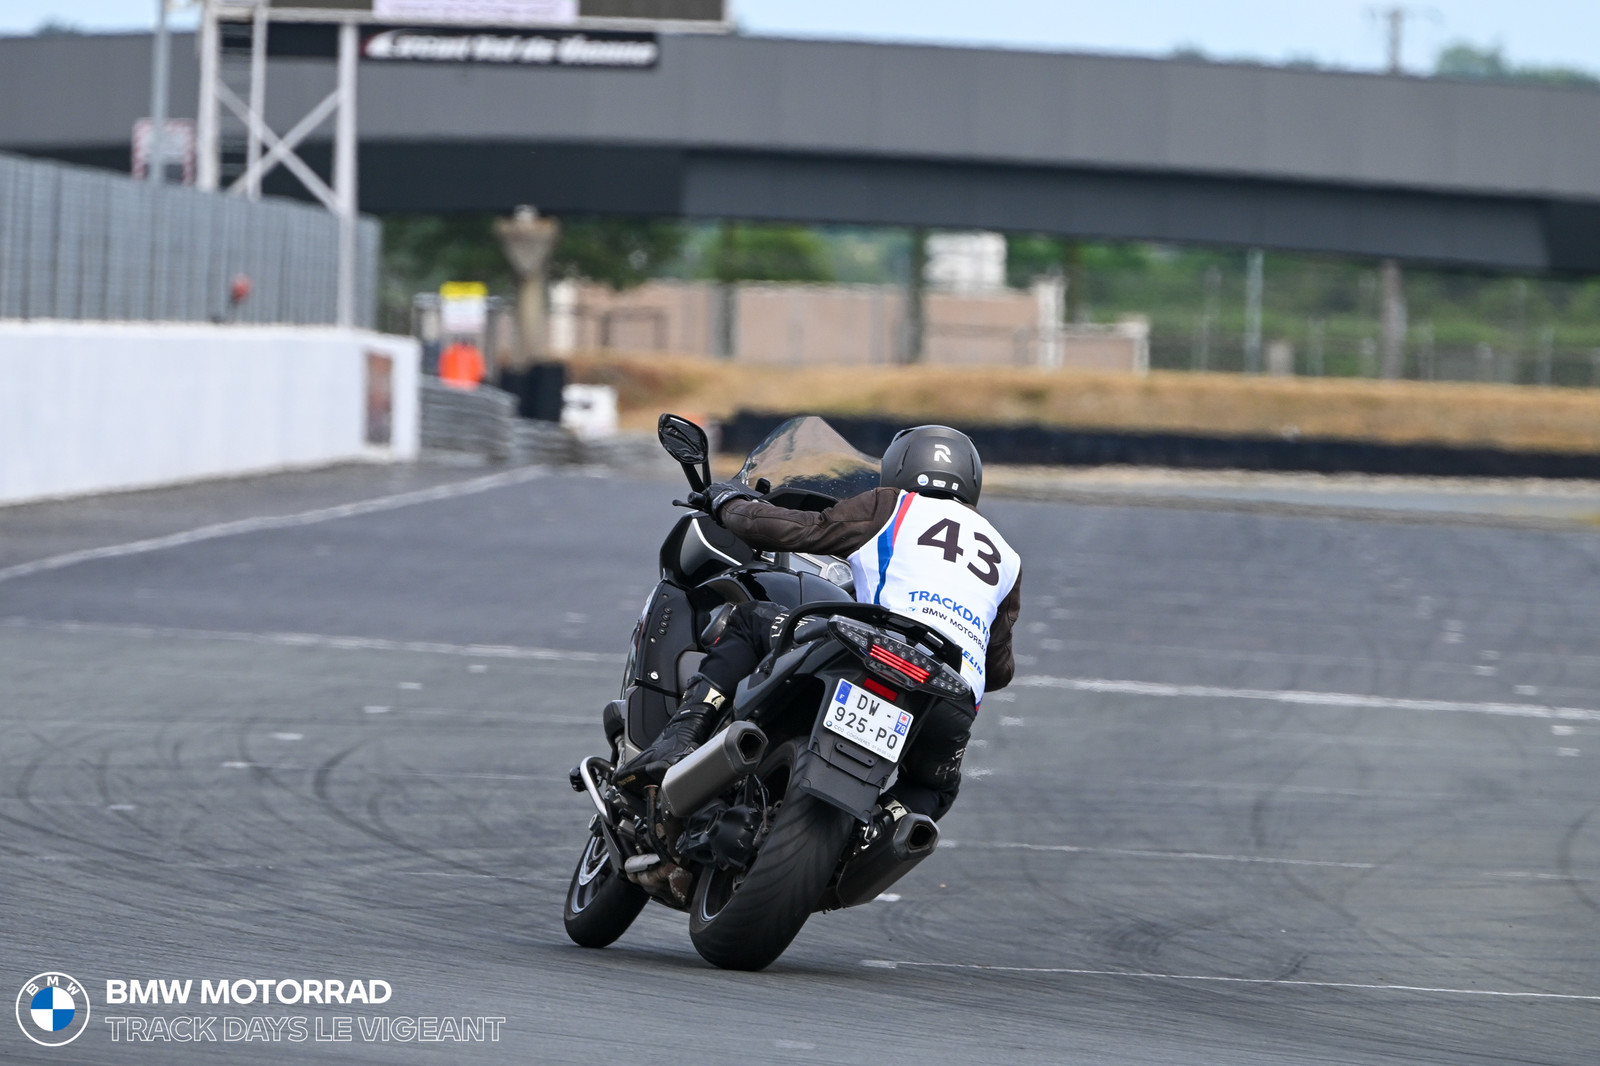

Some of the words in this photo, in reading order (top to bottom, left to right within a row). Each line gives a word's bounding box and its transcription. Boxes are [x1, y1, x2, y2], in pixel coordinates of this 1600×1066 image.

[917, 518, 1002, 586] 43
[922, 607, 948, 620] BMW
[962, 650, 983, 675] ELIN
[856, 694, 880, 716] DW
[895, 722, 906, 734] 78
